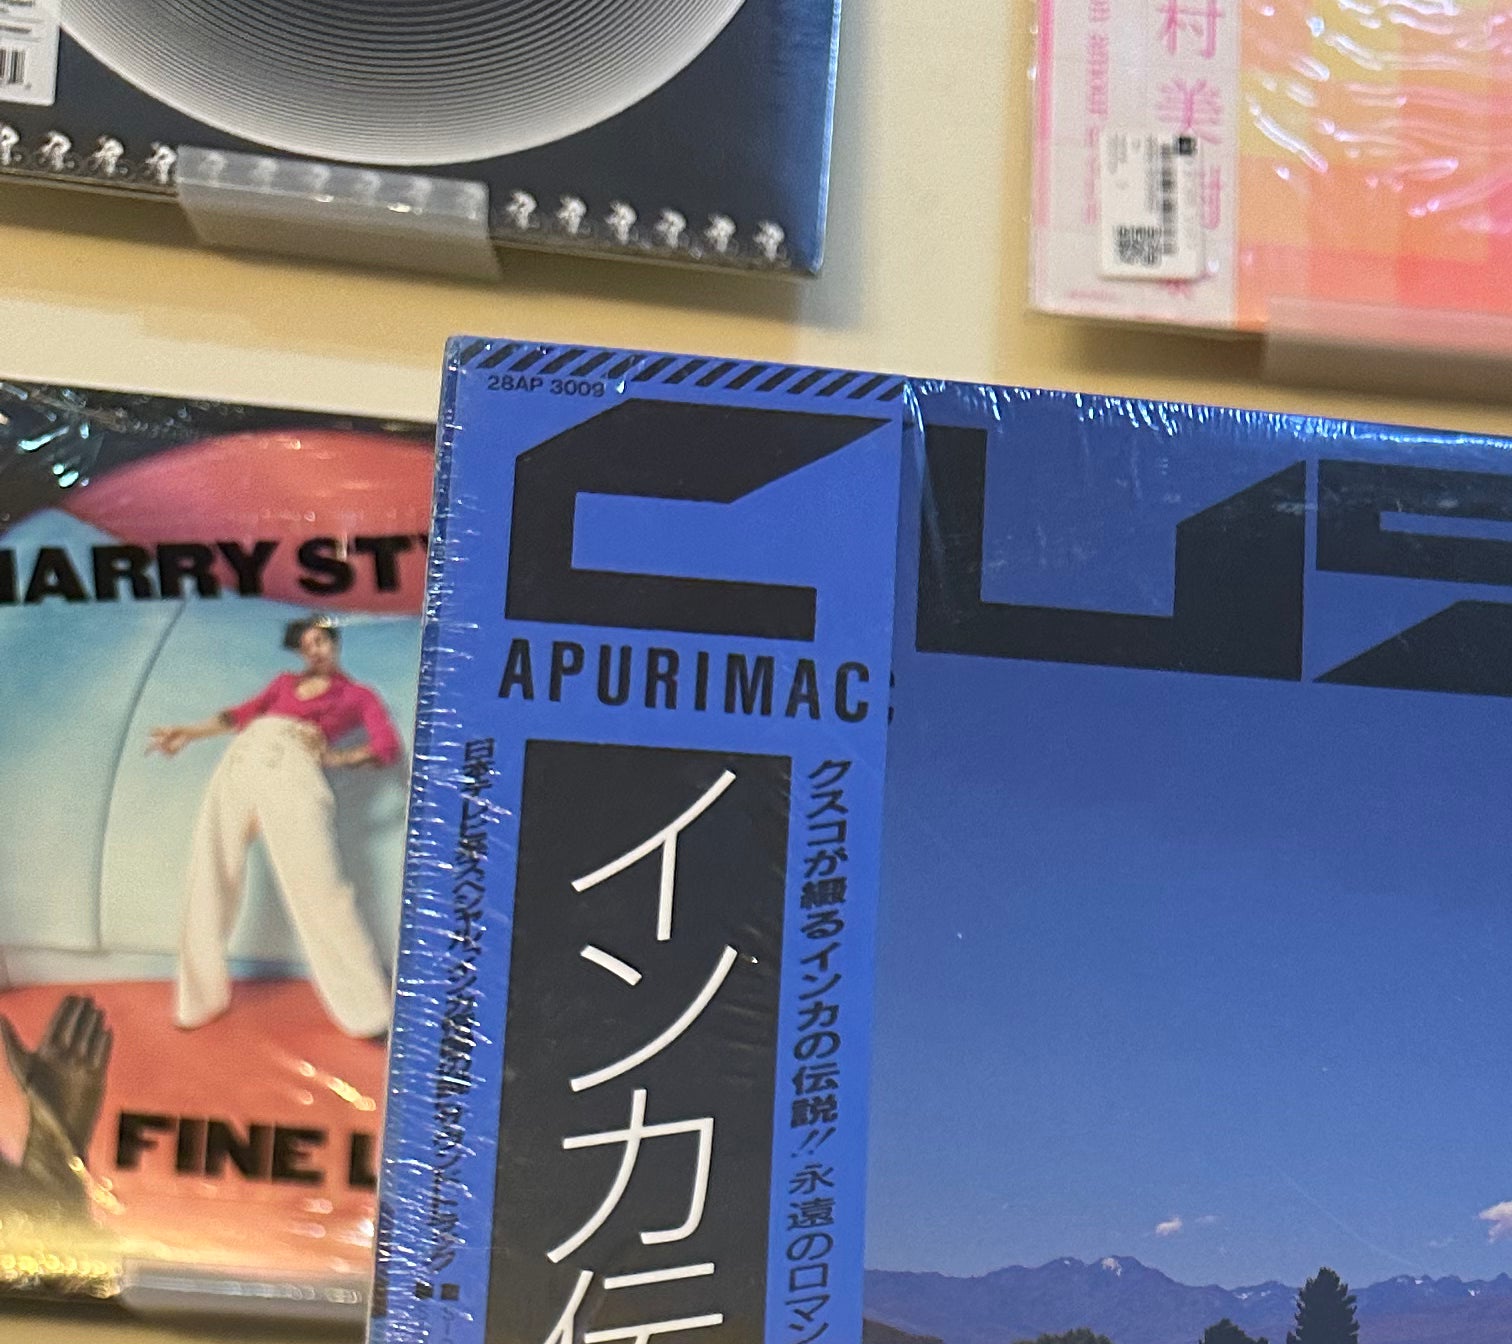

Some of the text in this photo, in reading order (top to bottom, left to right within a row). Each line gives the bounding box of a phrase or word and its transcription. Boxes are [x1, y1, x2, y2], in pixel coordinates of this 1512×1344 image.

[487, 374, 606, 398] 28AP 3009
[0, 534, 428, 607] ARRY ST
[498, 638, 872, 726] APURIMAC
[115, 1110, 327, 1185] FINE
